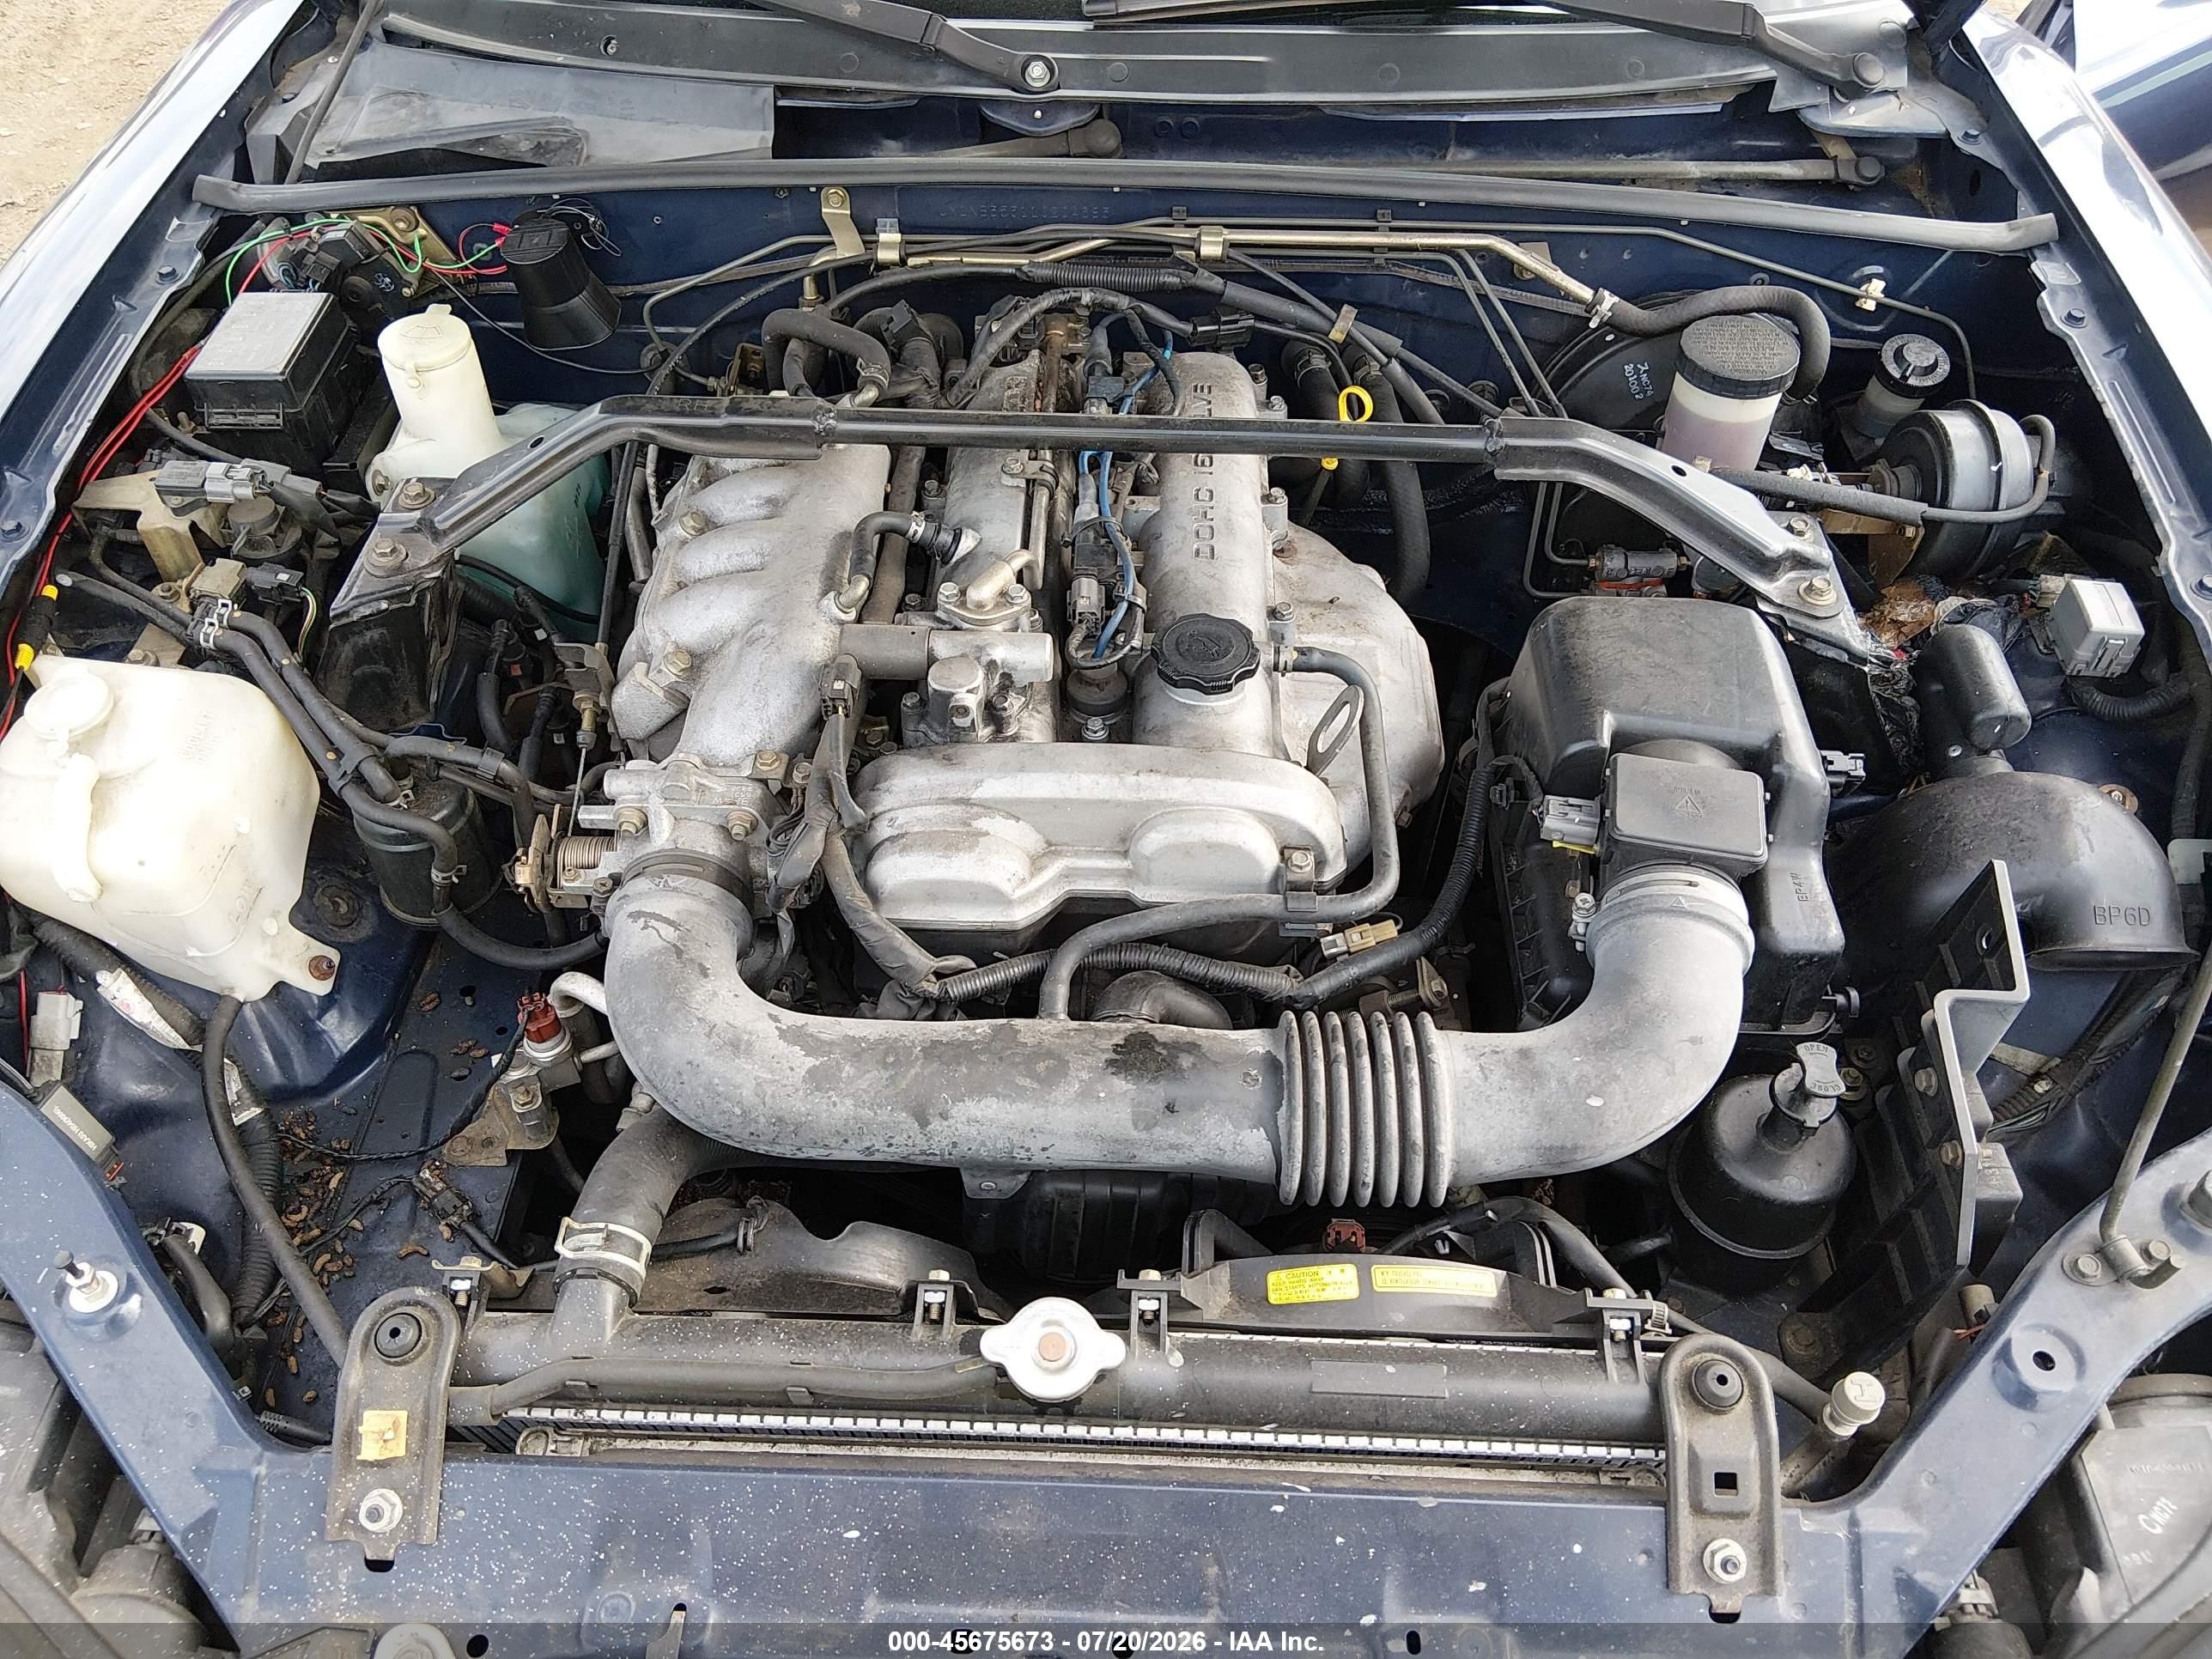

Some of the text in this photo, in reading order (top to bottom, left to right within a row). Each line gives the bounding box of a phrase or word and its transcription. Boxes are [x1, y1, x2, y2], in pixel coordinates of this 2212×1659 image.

[1191, 453, 1215, 477] 16
[1191, 486, 1216, 562] DOHC
[2093, 904, 2152, 927] BP6D
[1803, 1043, 1829, 1054] OPEN
[1809, 1082, 1842, 1093] CLOSE
[1285, 1270, 1320, 1279] CAUTION
